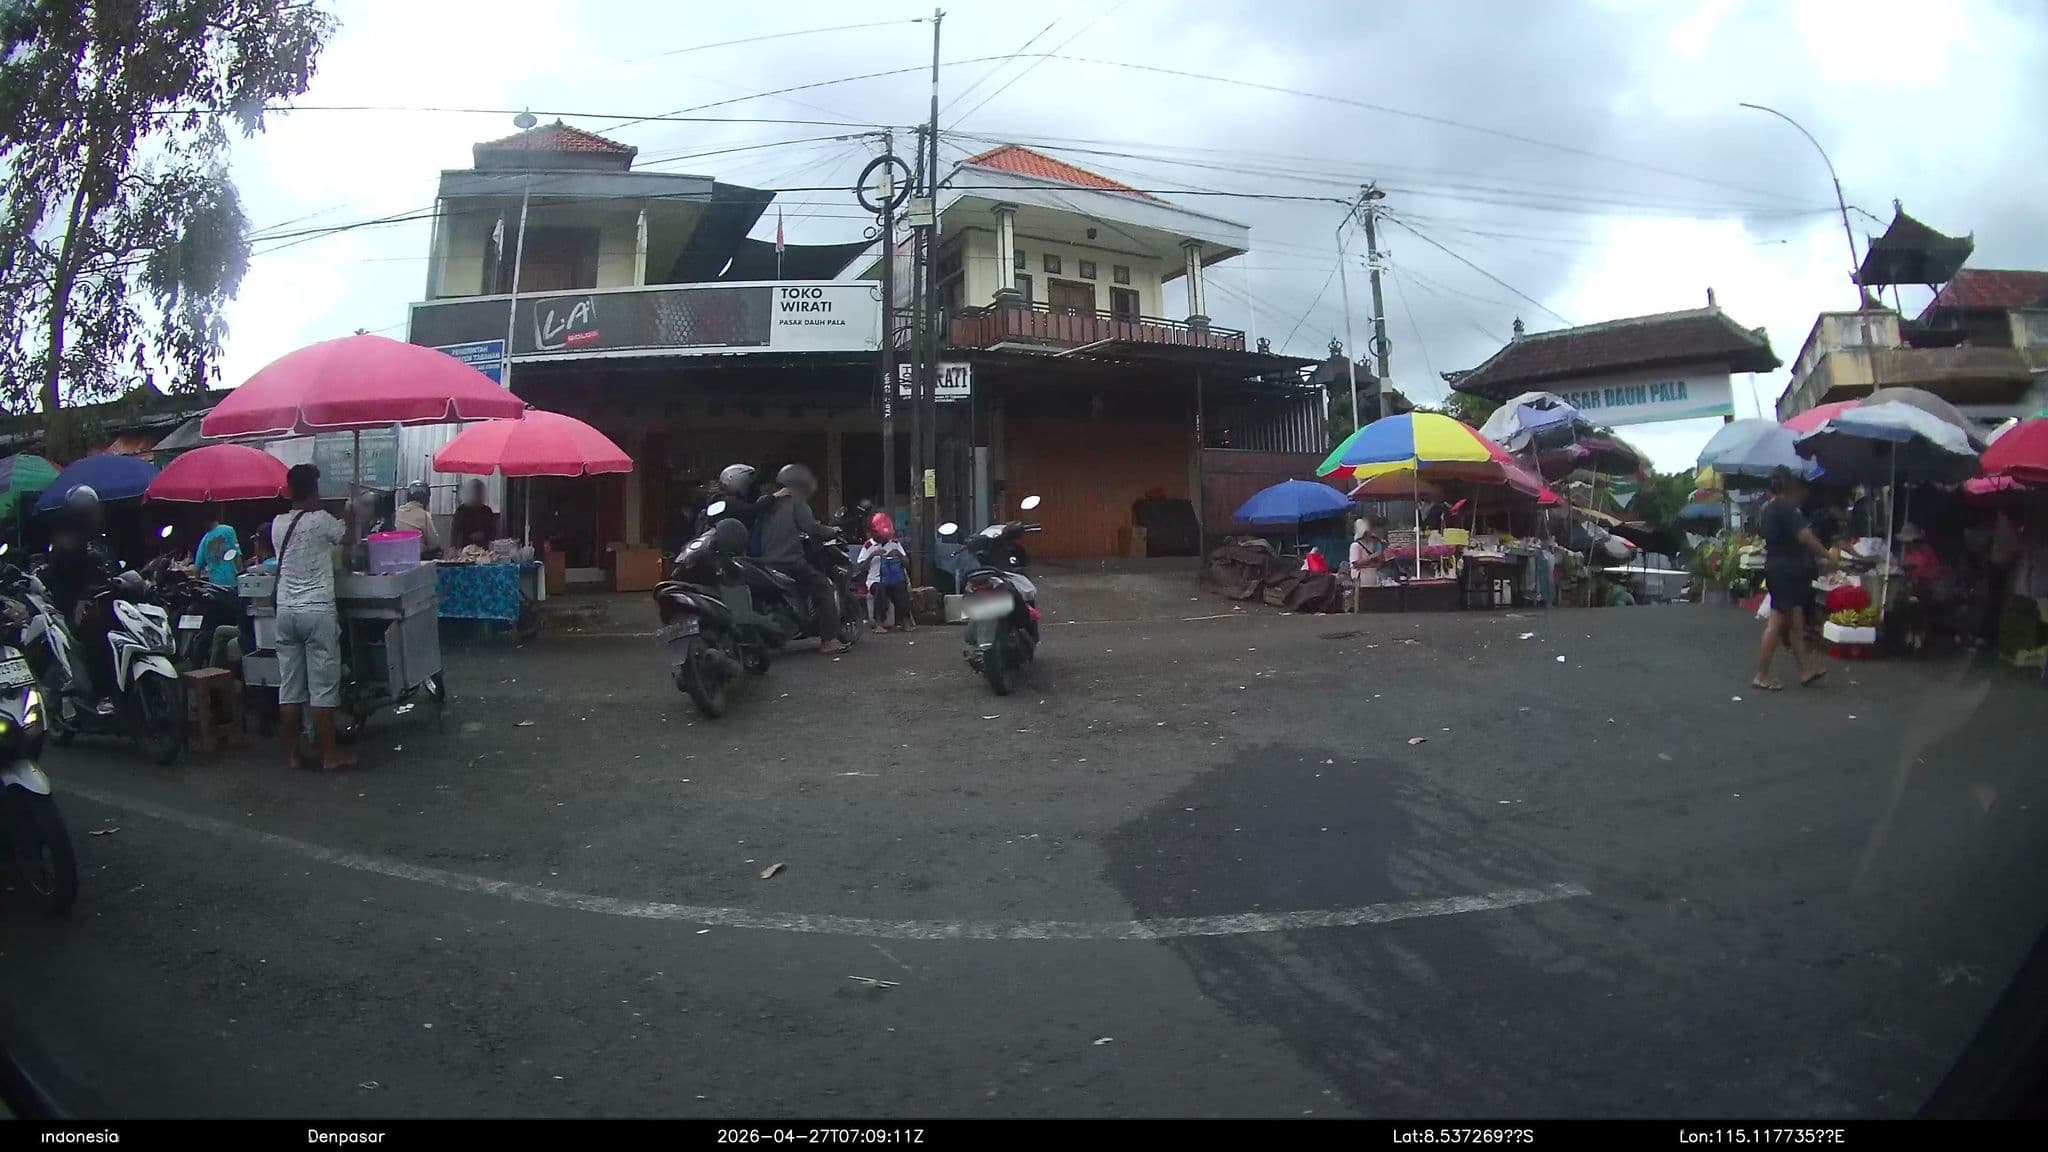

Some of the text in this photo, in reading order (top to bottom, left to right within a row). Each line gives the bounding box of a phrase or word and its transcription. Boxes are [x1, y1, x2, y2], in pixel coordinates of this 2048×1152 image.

[781, 288, 822, 299] TOKO
[781, 301, 832, 312] WIRATI
[1561, 390, 1601, 410] ASAR
[1649, 381, 1688, 403] PALA
